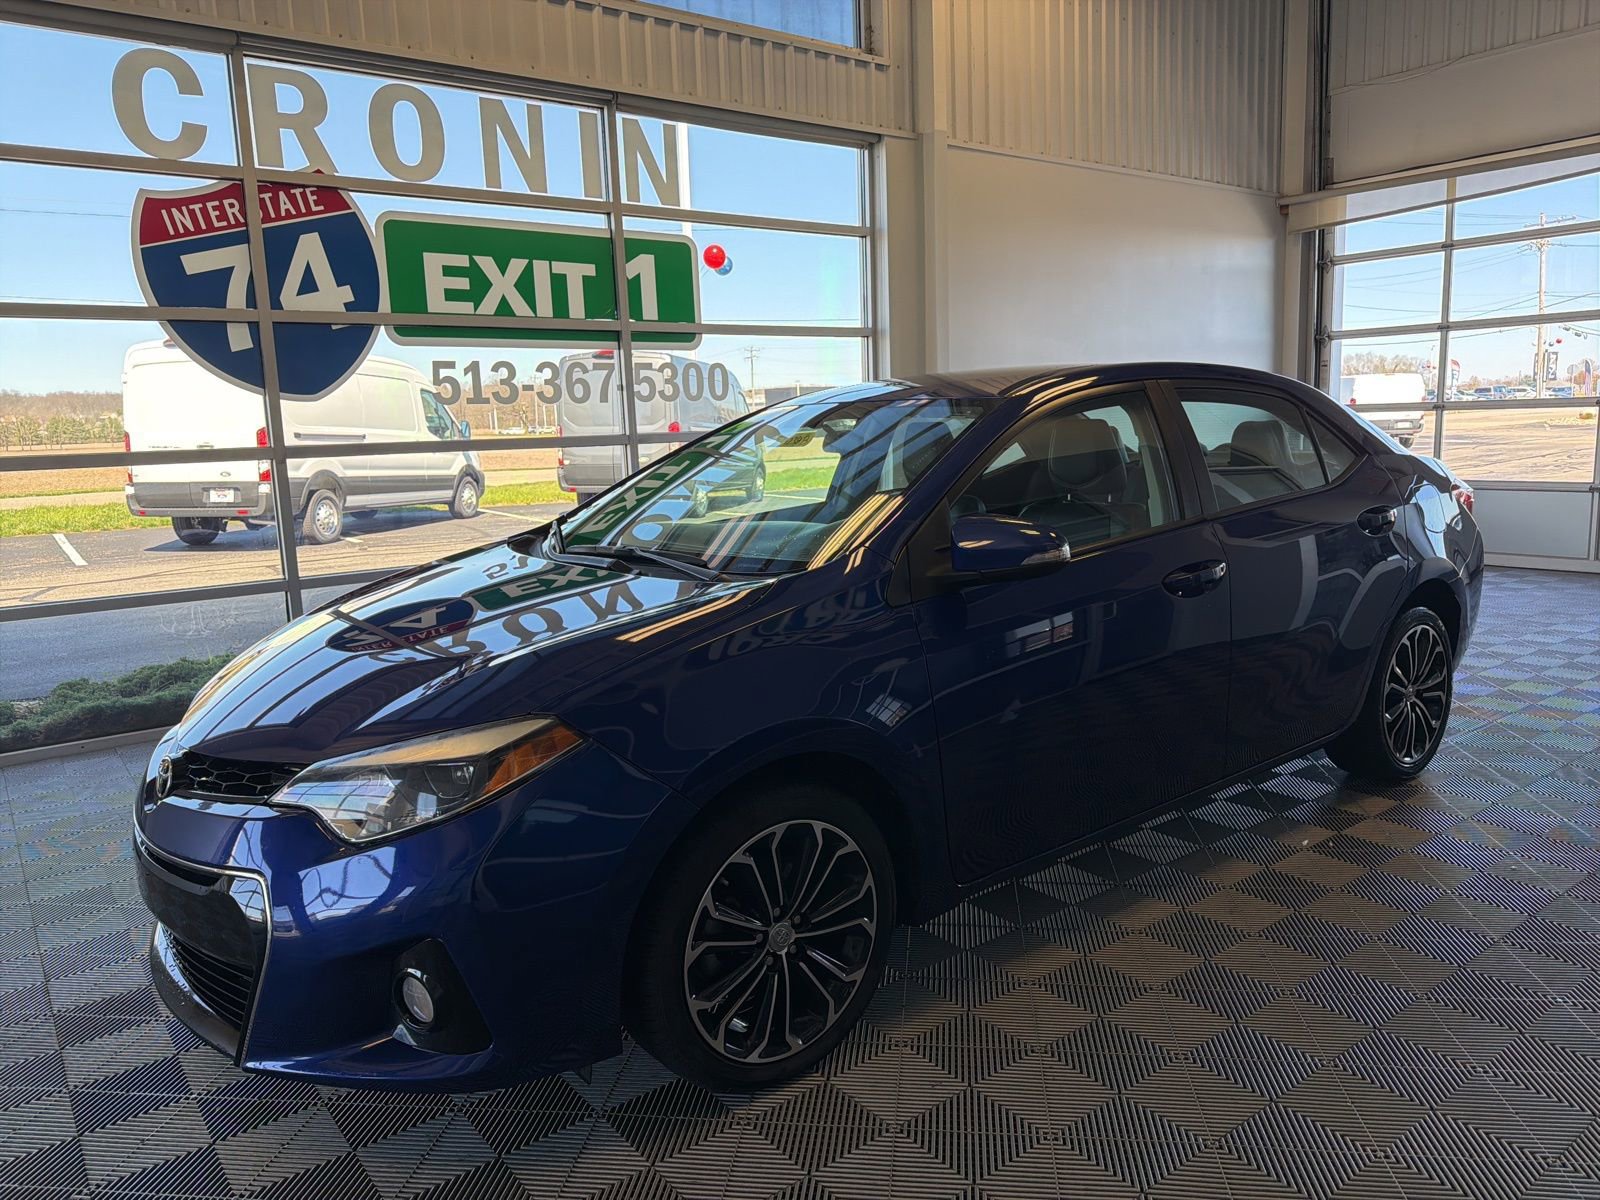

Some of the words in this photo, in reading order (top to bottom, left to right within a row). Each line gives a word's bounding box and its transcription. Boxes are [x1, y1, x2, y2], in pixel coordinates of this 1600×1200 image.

[111, 47, 682, 208] CRONIN
[179, 231, 356, 353] 74
[422, 251, 597, 320] EXIT
[625, 253, 660, 321] 1
